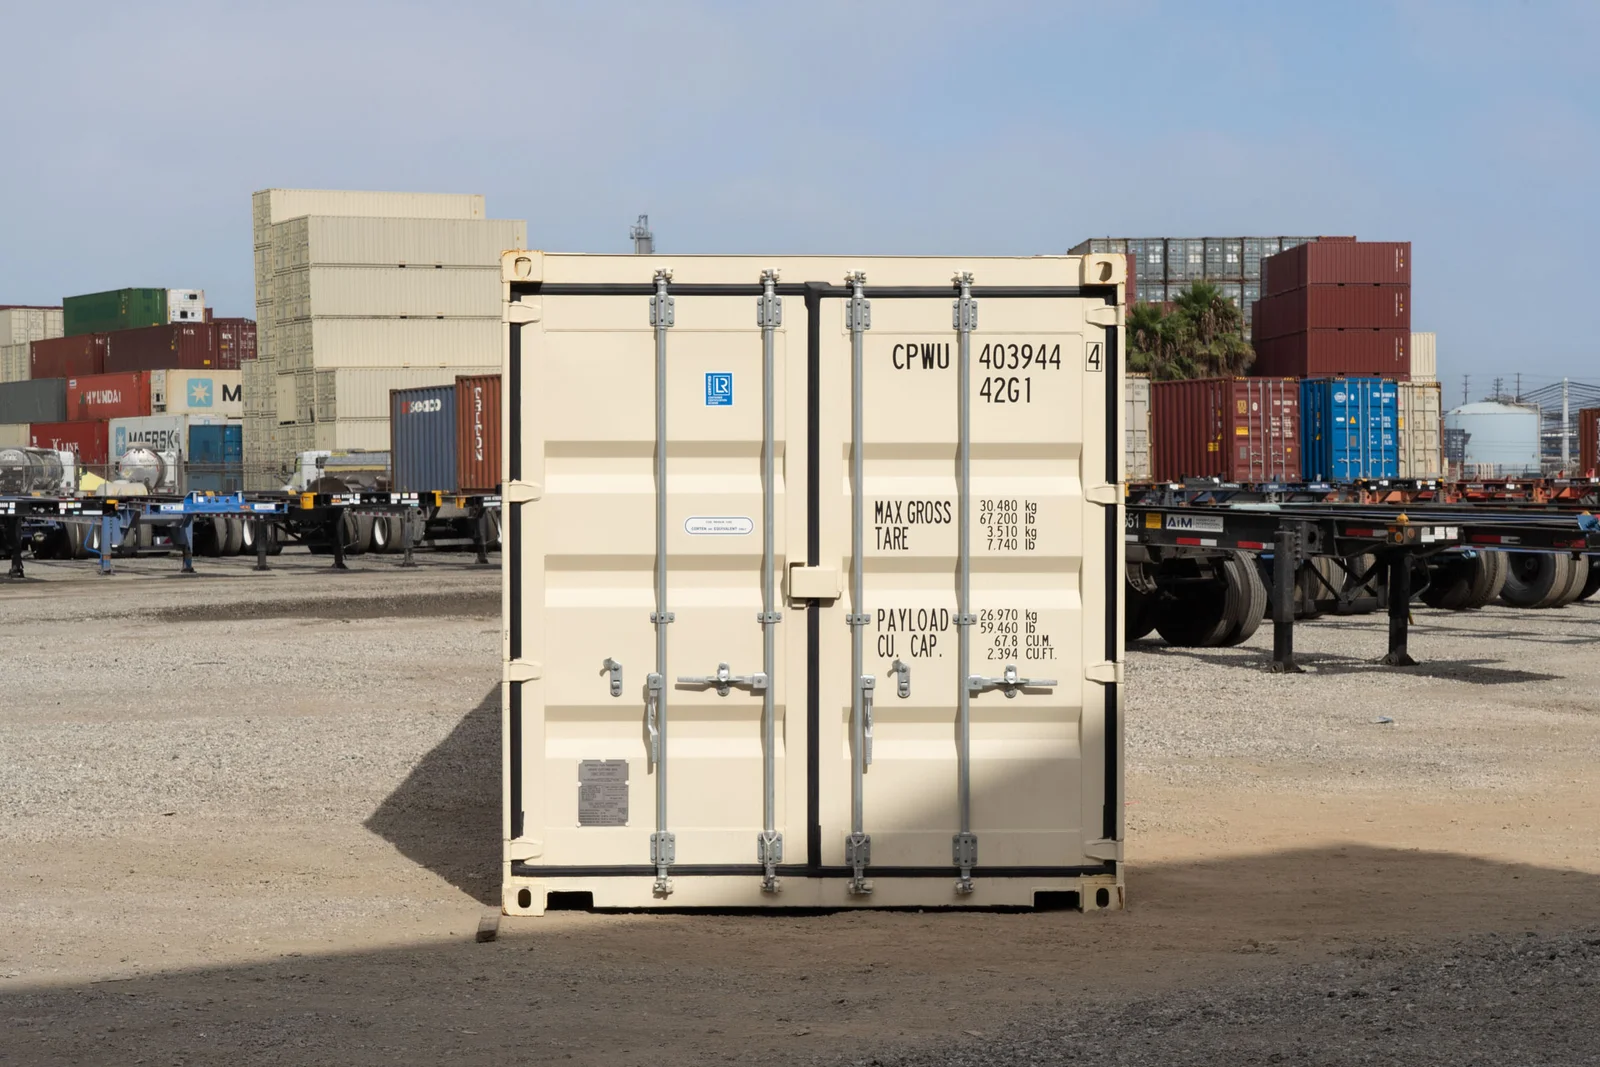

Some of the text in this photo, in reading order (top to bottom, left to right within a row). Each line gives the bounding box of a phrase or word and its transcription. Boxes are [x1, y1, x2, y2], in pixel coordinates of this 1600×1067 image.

[893, 343, 1101, 370] CPWU 403944 4
[715, 377, 729, 393] LR
[979, 377, 1031, 403] 42G1
[86, 389, 121, 405] HYUNDAI
[410, 399, 441, 413] seaco
[875, 501, 952, 524] MAX GROSS
[1025, 500, 1037, 514] kg
[1025, 512, 1036, 525] lb
[875, 527, 909, 550] TARE
[1025, 526, 1037, 541] kg
[1025, 538, 1036, 551] lb
[878, 608, 949, 632] PAYLOAD
[981, 609, 1037, 623] 26.970 kg
[981, 622, 1036, 634] 59.460 lb
[878, 634, 943, 658] CU. CAP.
[995, 635, 1018, 648] 67.8
[988, 647, 1018, 660] 2.394
